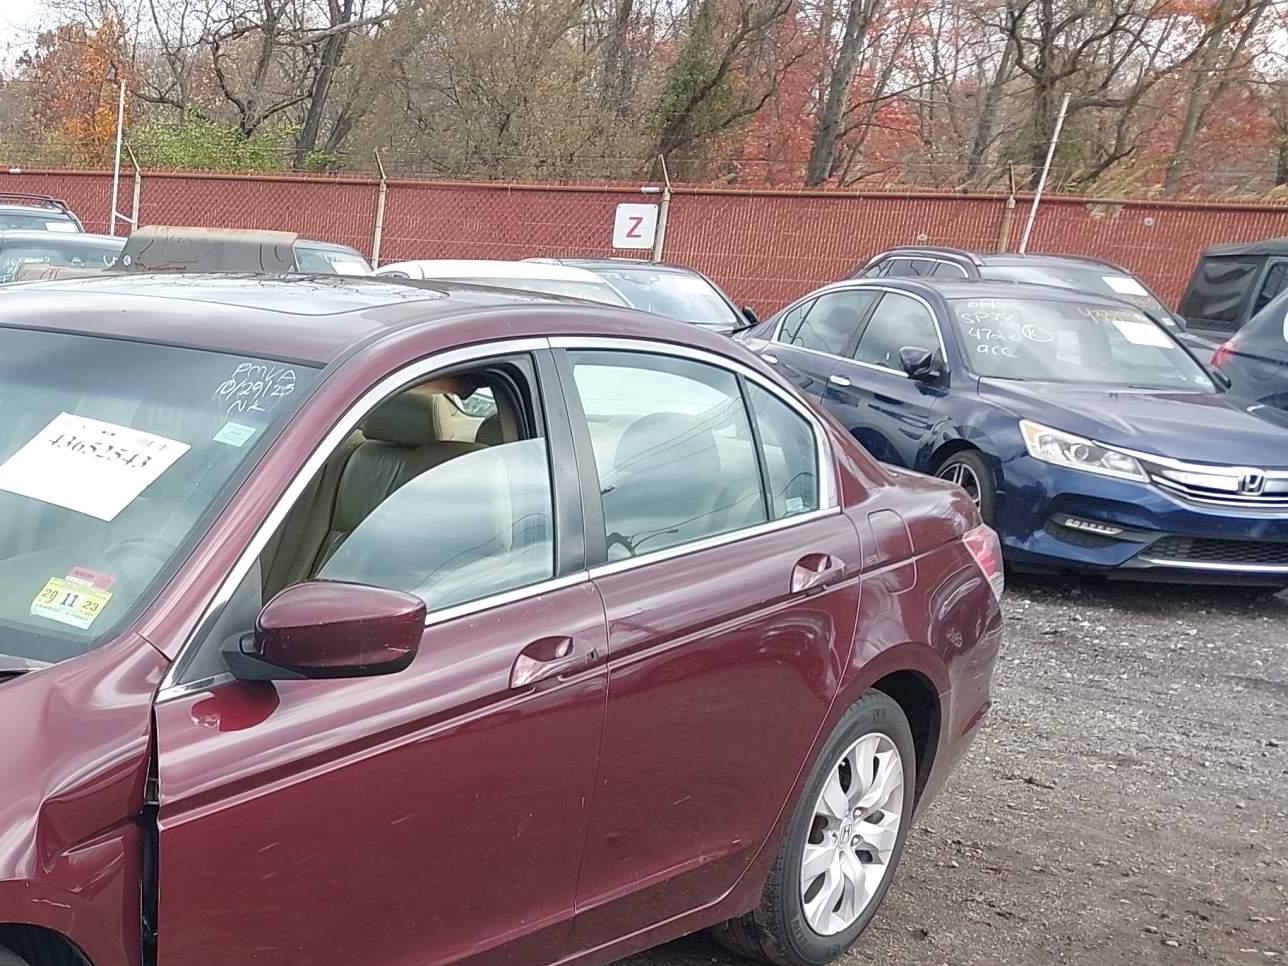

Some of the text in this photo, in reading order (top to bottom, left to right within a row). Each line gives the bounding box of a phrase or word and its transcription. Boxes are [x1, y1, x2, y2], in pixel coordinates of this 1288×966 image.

[626, 216, 644, 238] Z
[48, 433, 153, 468] 43652543
[59, 592, 80, 608] 11
[81, 600, 101, 612] 23
